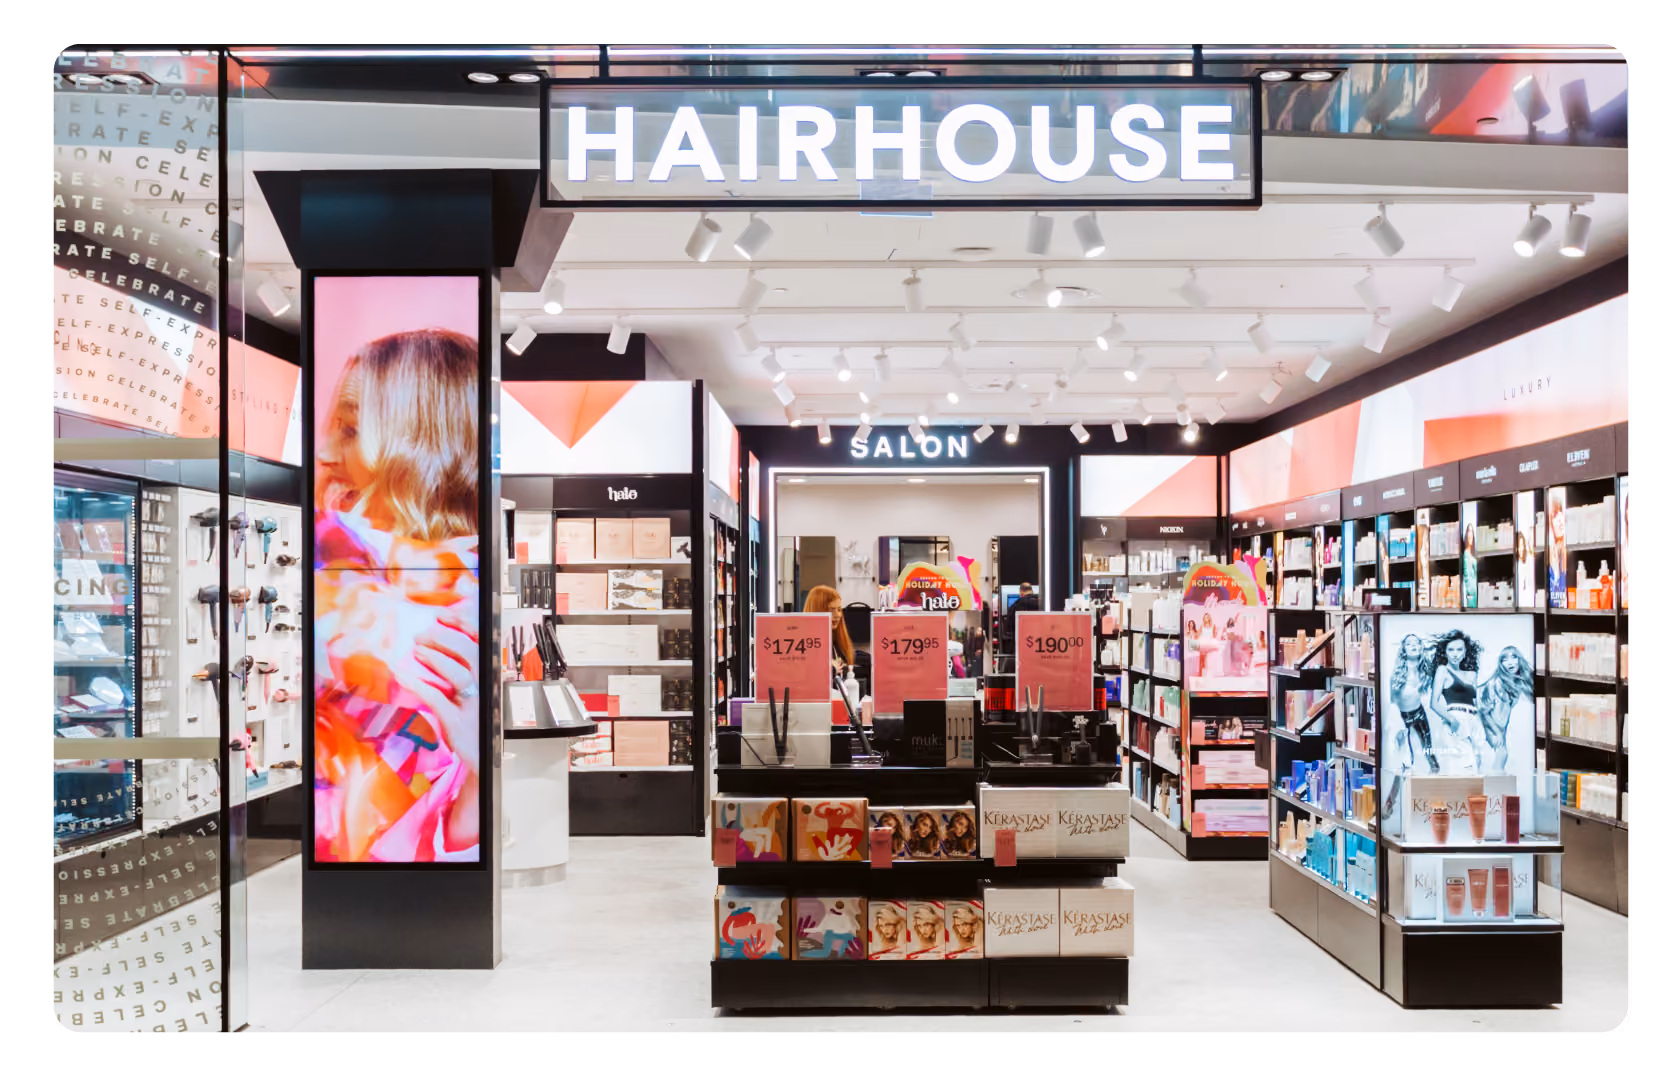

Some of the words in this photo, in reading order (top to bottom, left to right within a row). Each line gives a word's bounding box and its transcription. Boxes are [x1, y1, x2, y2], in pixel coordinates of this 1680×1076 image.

[53, 122, 152, 145] RATE
[567, 103, 1234, 182] HAIRHOUSE
[68, 267, 206, 314] CELEBRATE
[107, 373, 197, 423] CELEBRATE
[1503, 373, 1551, 401] LUXURY
[53, 391, 138, 416] CELEBRATE
[850, 434, 968, 458] SALON
[607, 486, 638, 502] halo
[54, 578, 130, 596] CING
[920, 591, 960, 610] halo
[58, 861, 195, 905] SELF-EXPRE
[57, 1000, 167, 1026] CELEB
